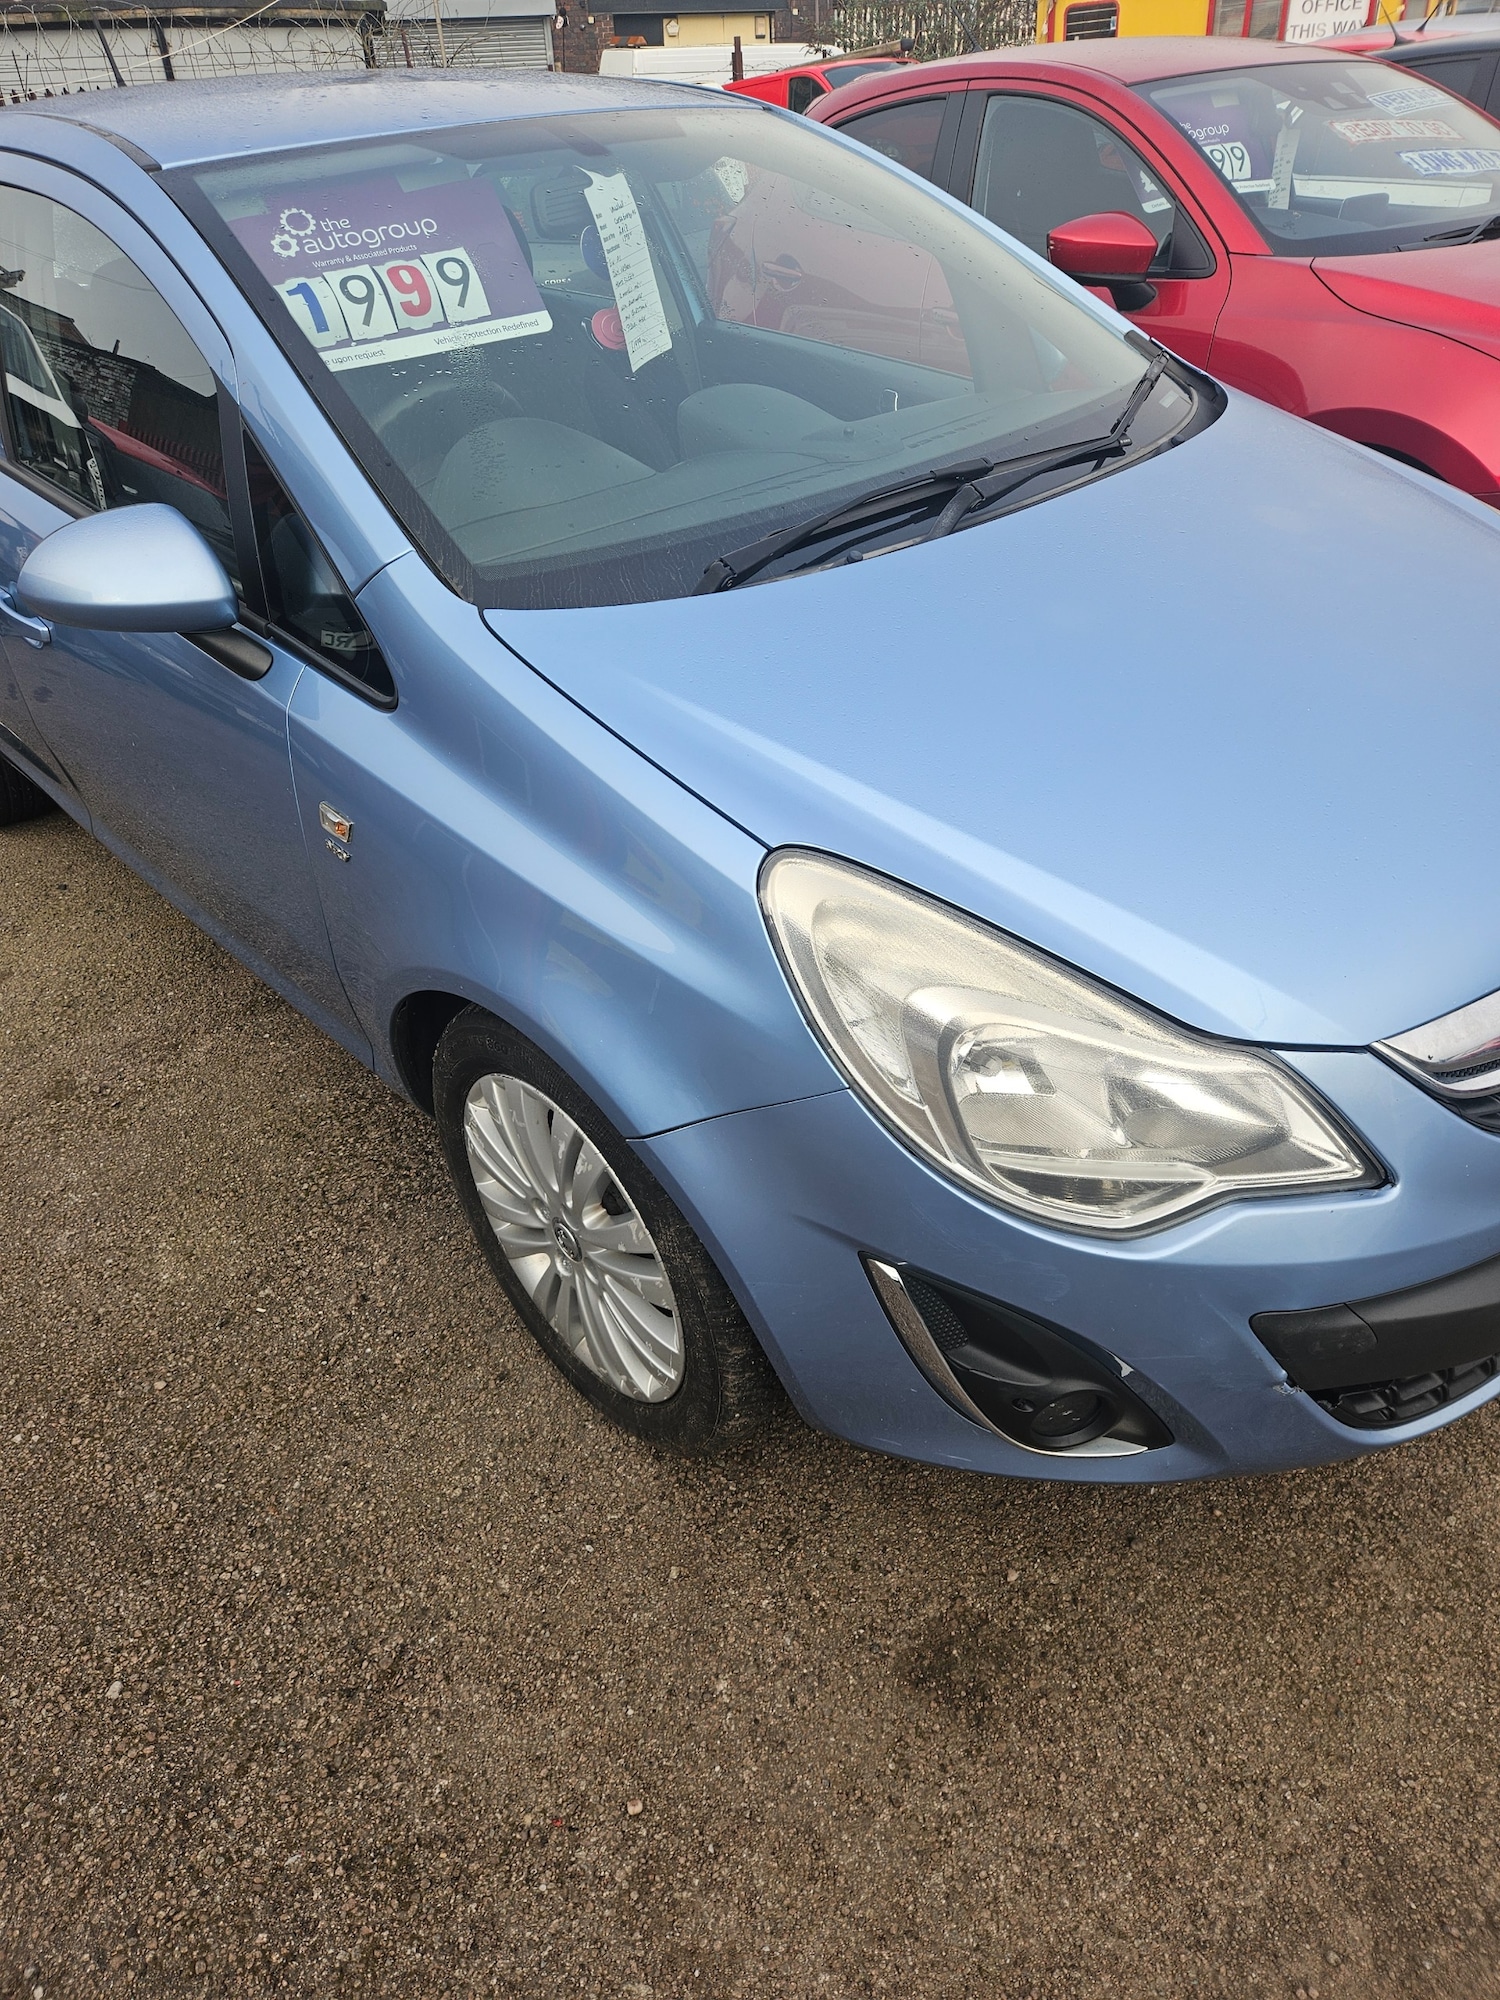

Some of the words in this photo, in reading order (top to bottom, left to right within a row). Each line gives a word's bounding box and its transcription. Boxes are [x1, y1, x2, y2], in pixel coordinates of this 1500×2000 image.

[1302, 0, 1362, 14] OFFICE
[1290, 22, 1327, 39] THIS
[1373, 91, 1415, 107] NEW
[1180, 122, 1191, 130] he
[1188, 123, 1230, 140] ogroup
[1346, 122, 1400, 138] READY
[1396, 121, 1425, 135] TO
[1423, 122, 1451, 136] GO
[1405, 152, 1466, 172] LONG
[320, 217, 351, 232] the
[303, 218, 438, 254] autogroup
[312, 256, 345, 268] Warranty
[345, 253, 352, 262] &
[352, 248, 388, 261] Associated
[388, 244, 417, 256] Products
[286, 257, 470, 334] 1999
[433, 333, 462, 346] Vehicle
[462, 326, 502, 342] Protection
[502, 318, 539, 335] Redefined
[332, 353, 353, 365] upon
[354, 348, 386, 362] request
